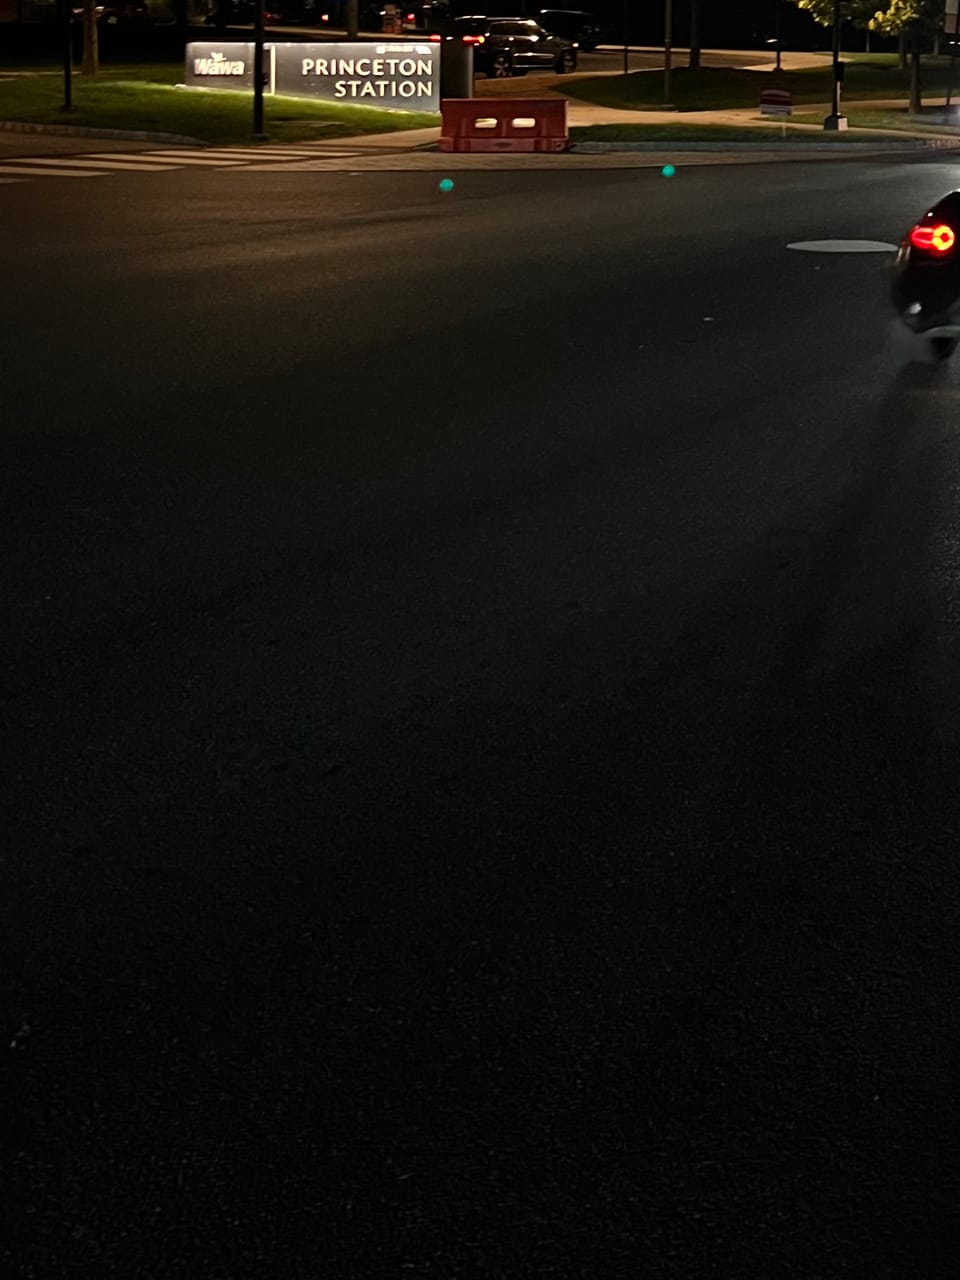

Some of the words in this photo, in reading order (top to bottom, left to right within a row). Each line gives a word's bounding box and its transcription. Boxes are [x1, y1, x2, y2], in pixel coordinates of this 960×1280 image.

[194, 59, 245, 76] Wawa
[302, 58, 432, 76] PRINCETON
[335, 80, 432, 97] STATION
